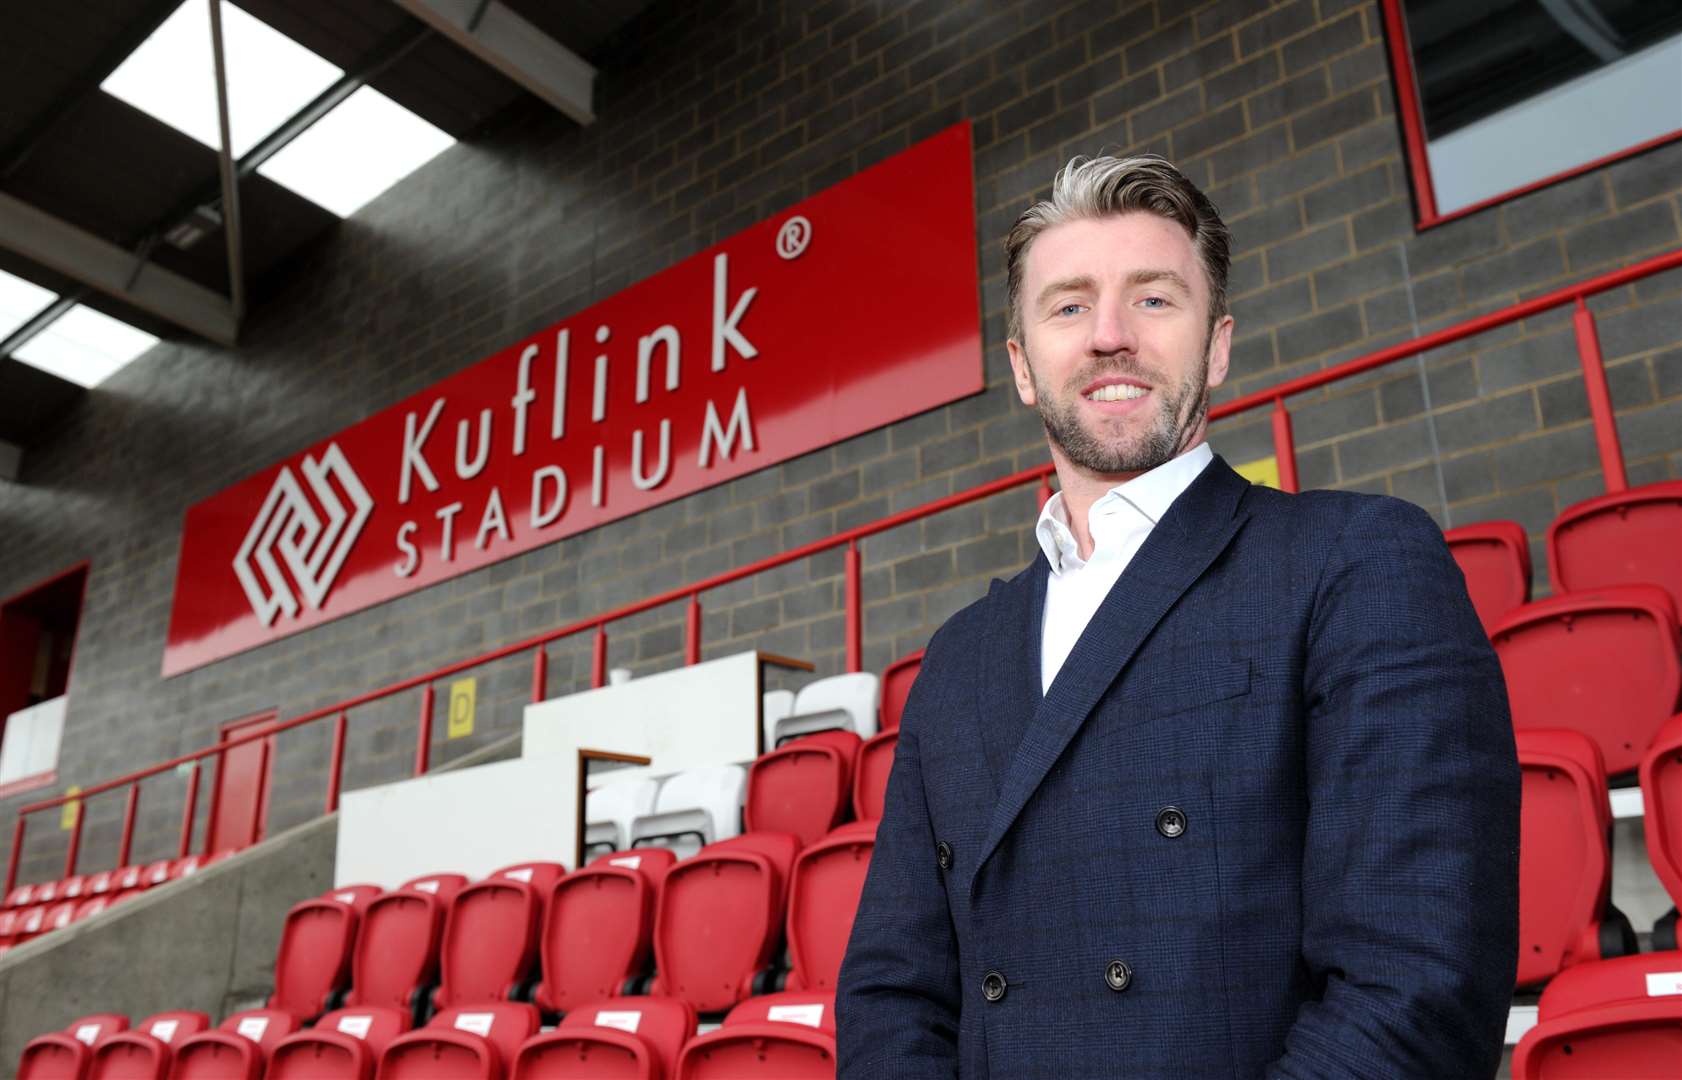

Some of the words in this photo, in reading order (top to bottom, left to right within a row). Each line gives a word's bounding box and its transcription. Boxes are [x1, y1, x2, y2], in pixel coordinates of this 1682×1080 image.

[398, 252, 759, 504] Kuflink
[393, 386, 755, 577] STADIUM
[453, 694, 471, 725] D
